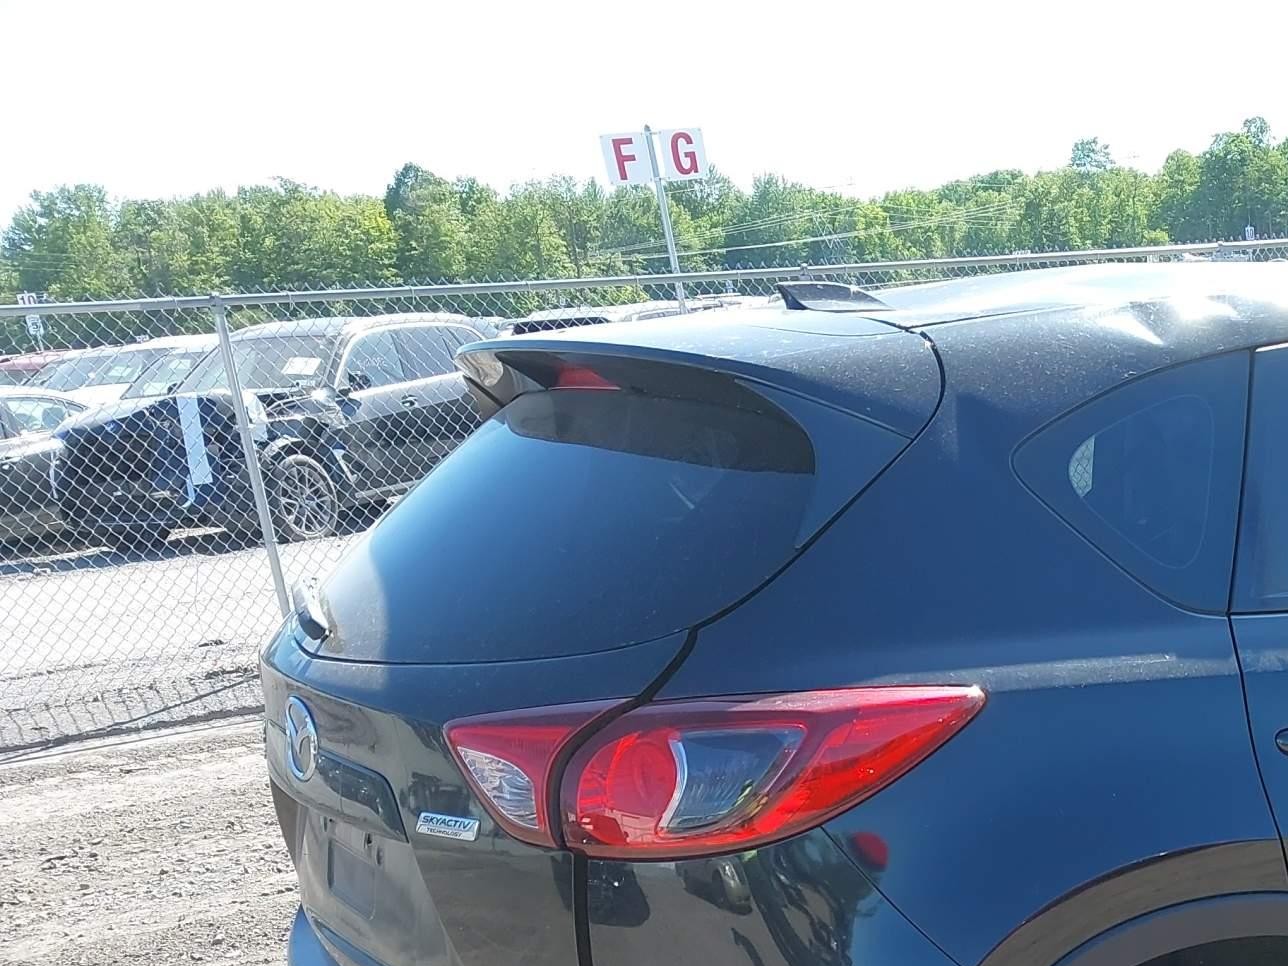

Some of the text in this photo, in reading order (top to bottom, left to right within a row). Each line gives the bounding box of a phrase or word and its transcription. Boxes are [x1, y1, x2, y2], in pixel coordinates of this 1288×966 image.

[612, 137, 636, 180] F
[670, 132, 699, 175] G
[422, 815, 474, 831] SKYACTIV
[426, 827, 463, 838] TECHNOLOGY
